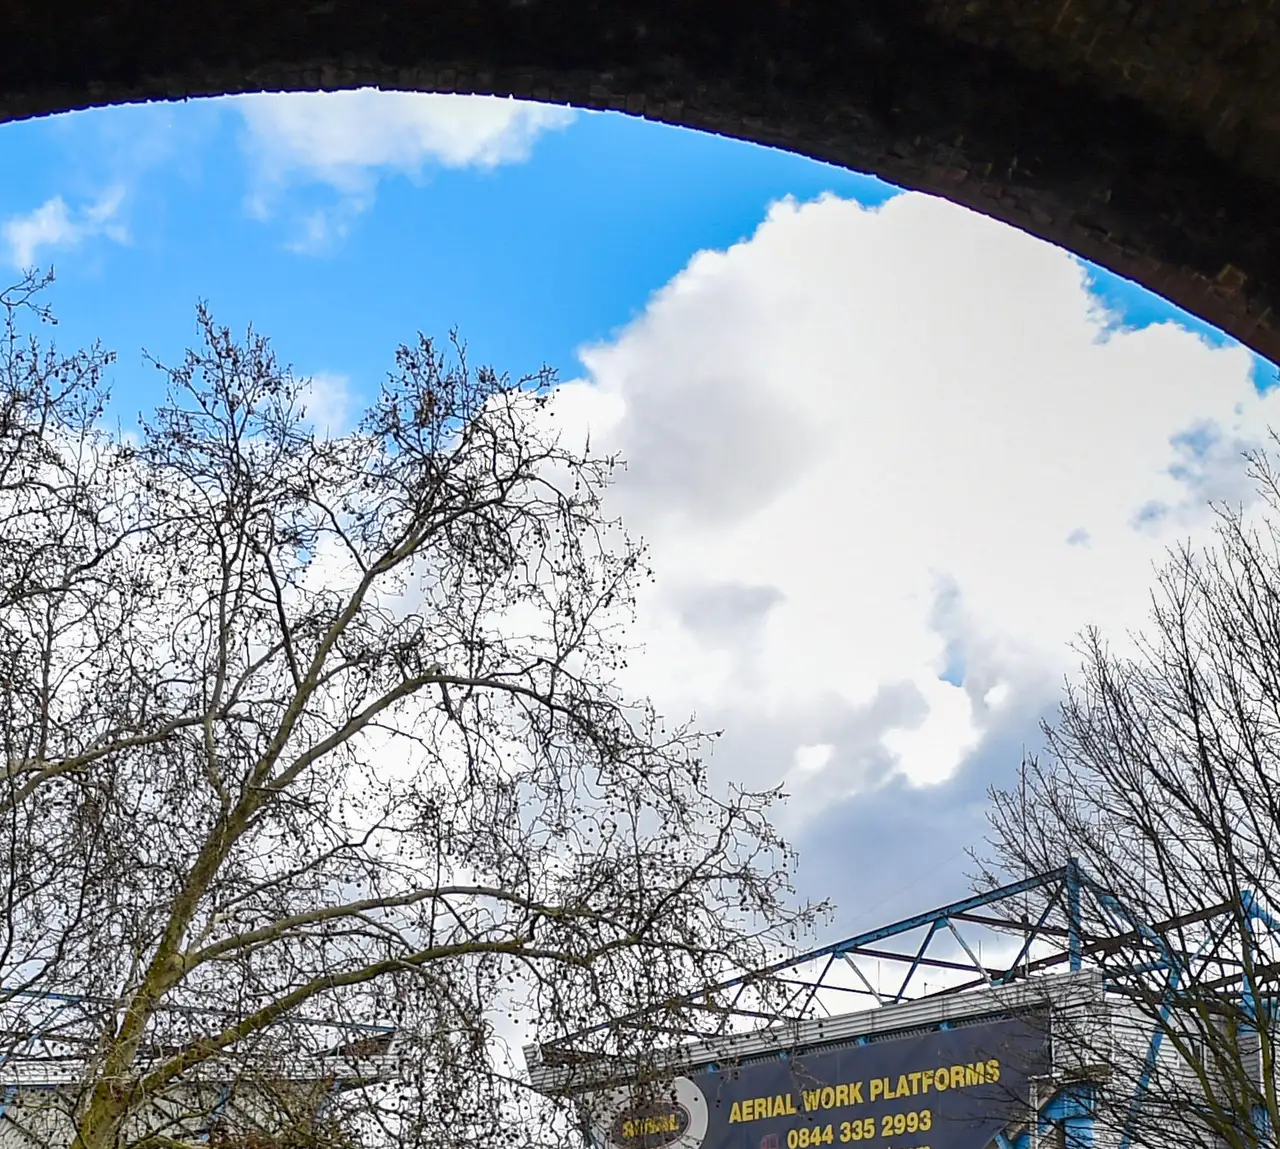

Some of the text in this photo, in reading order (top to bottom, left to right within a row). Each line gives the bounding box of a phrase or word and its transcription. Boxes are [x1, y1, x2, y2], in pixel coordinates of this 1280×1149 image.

[729, 1059, 1000, 1124] AERIAL WORK PLATFORMS
[839, 1117, 875, 1144] 335
[882, 1110, 931, 1137] 2993
